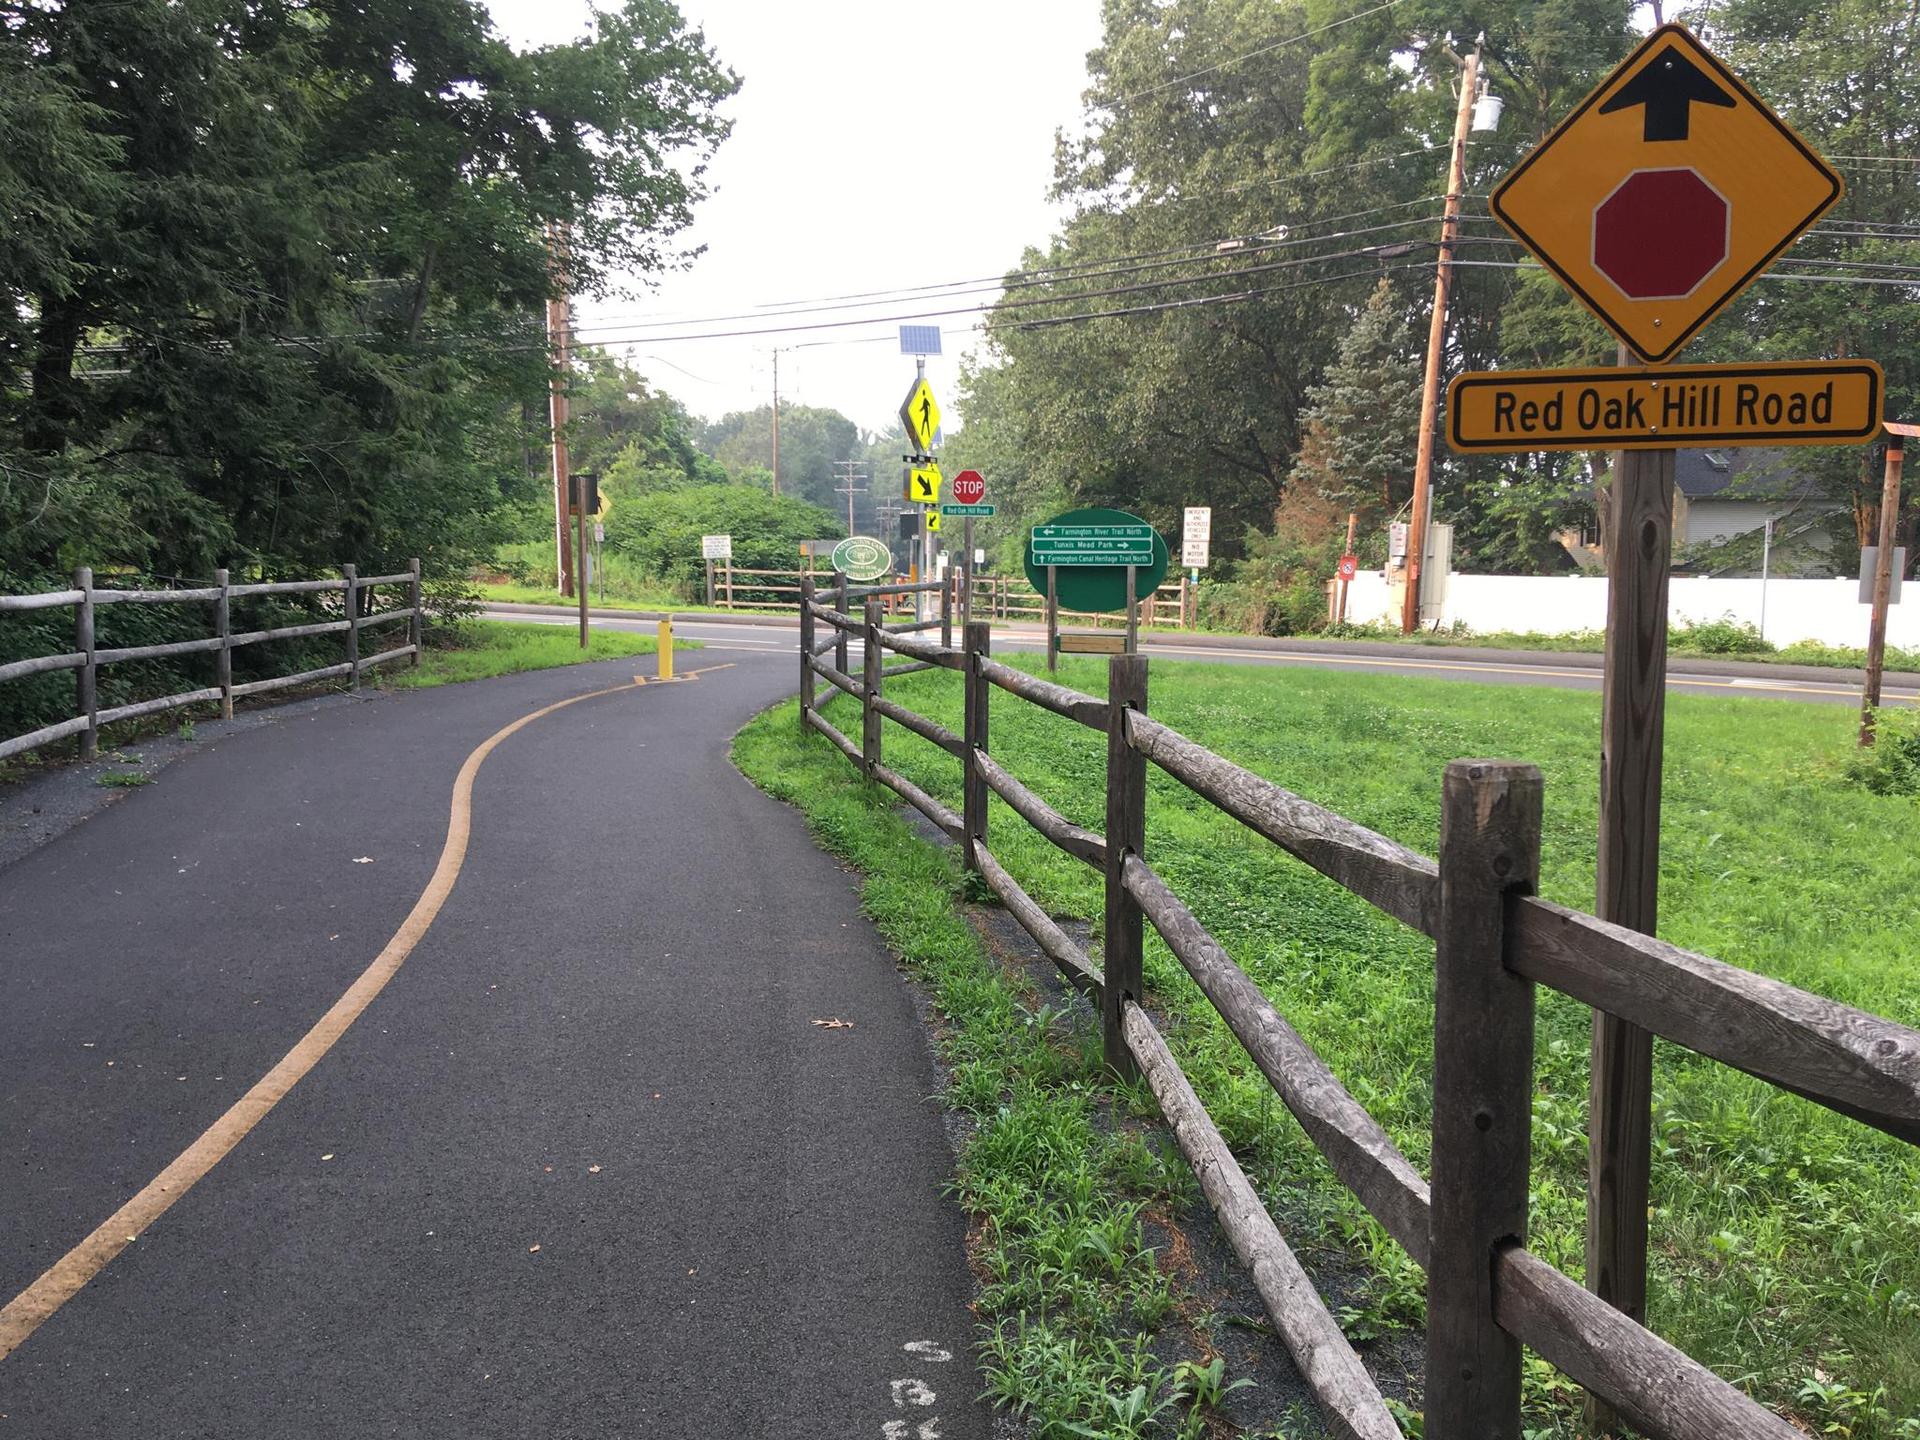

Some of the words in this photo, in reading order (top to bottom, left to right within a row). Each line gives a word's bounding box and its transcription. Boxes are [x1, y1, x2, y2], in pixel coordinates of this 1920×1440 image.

[1494, 389, 1564, 433] Red
[1577, 386, 1646, 431] Oak
[1661, 384, 1722, 428] Hill
[1736, 380, 1833, 426] Road
[954, 481, 983, 494] STOP
[947, 507, 957, 515] Red
[957, 507, 967, 515] Oak
[967, 507, 976, 515] Hill
[976, 507, 989, 515] Road
[1061, 528, 1092, 536] Farmington
[1048, 555, 1078, 563] Farmington
[1078, 554, 1094, 562] Canal
[1095, 554, 1118, 563] Heritage
[1119, 554, 1132, 562] Trail
[1133, 554, 1148, 562] North
